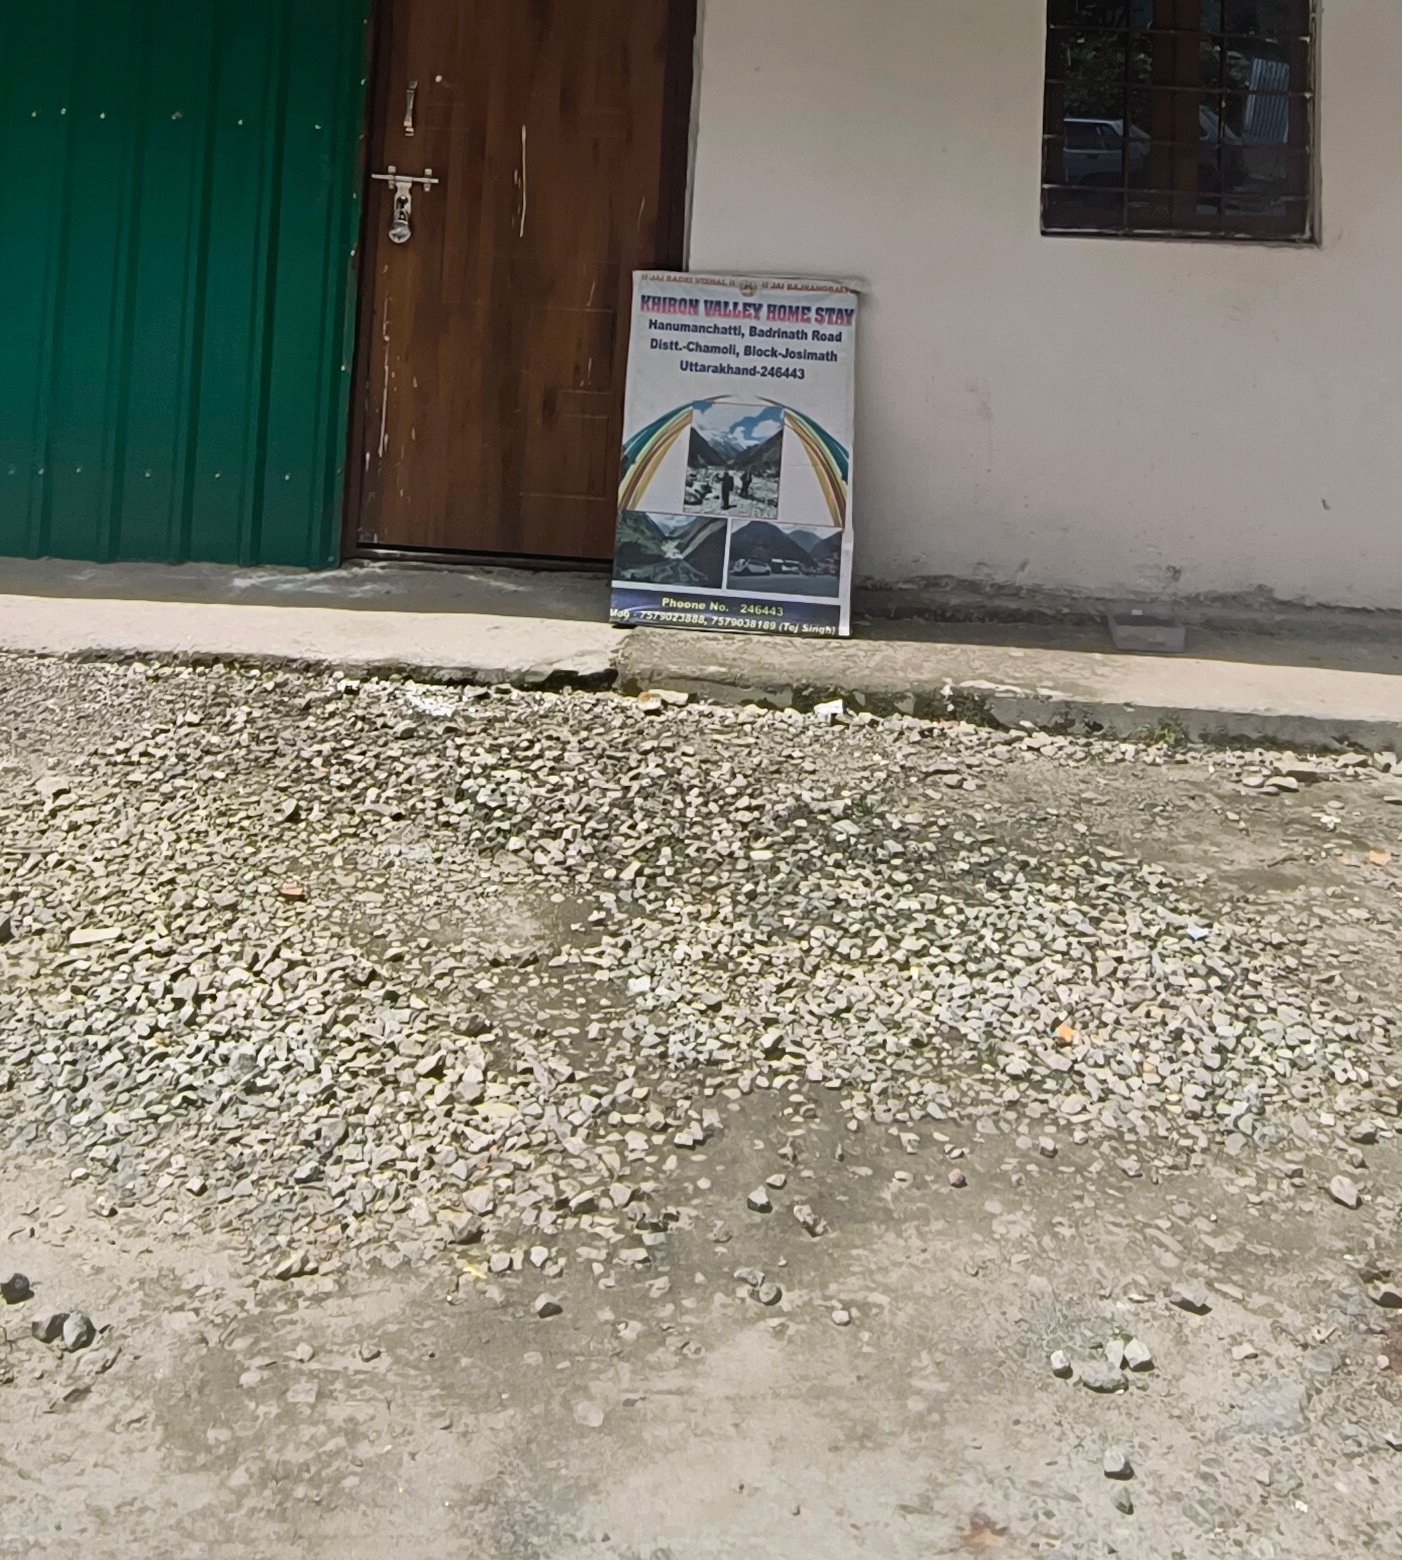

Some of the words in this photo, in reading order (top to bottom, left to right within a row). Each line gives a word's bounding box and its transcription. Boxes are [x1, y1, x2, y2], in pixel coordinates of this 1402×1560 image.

[640, 295, 700, 316] KHIRON
[703, 299, 763, 321] VALLEY
[766, 303, 812, 324] HOME
[814, 306, 855, 327] STAY
[648, 319, 745, 339] Hanumanchatti,
[748, 325, 808, 341] Badrinath
[811, 330, 843, 342] Road
[743, 345, 838, 362] Block-Josimath
[680, 360, 805, 380] Uttarakhand-246443
[661, 597, 706, 610] Phoone
[709, 602, 729, 612] No.
[739, 604, 784, 617] 246443
[801, 624, 836, 635] Singh)
